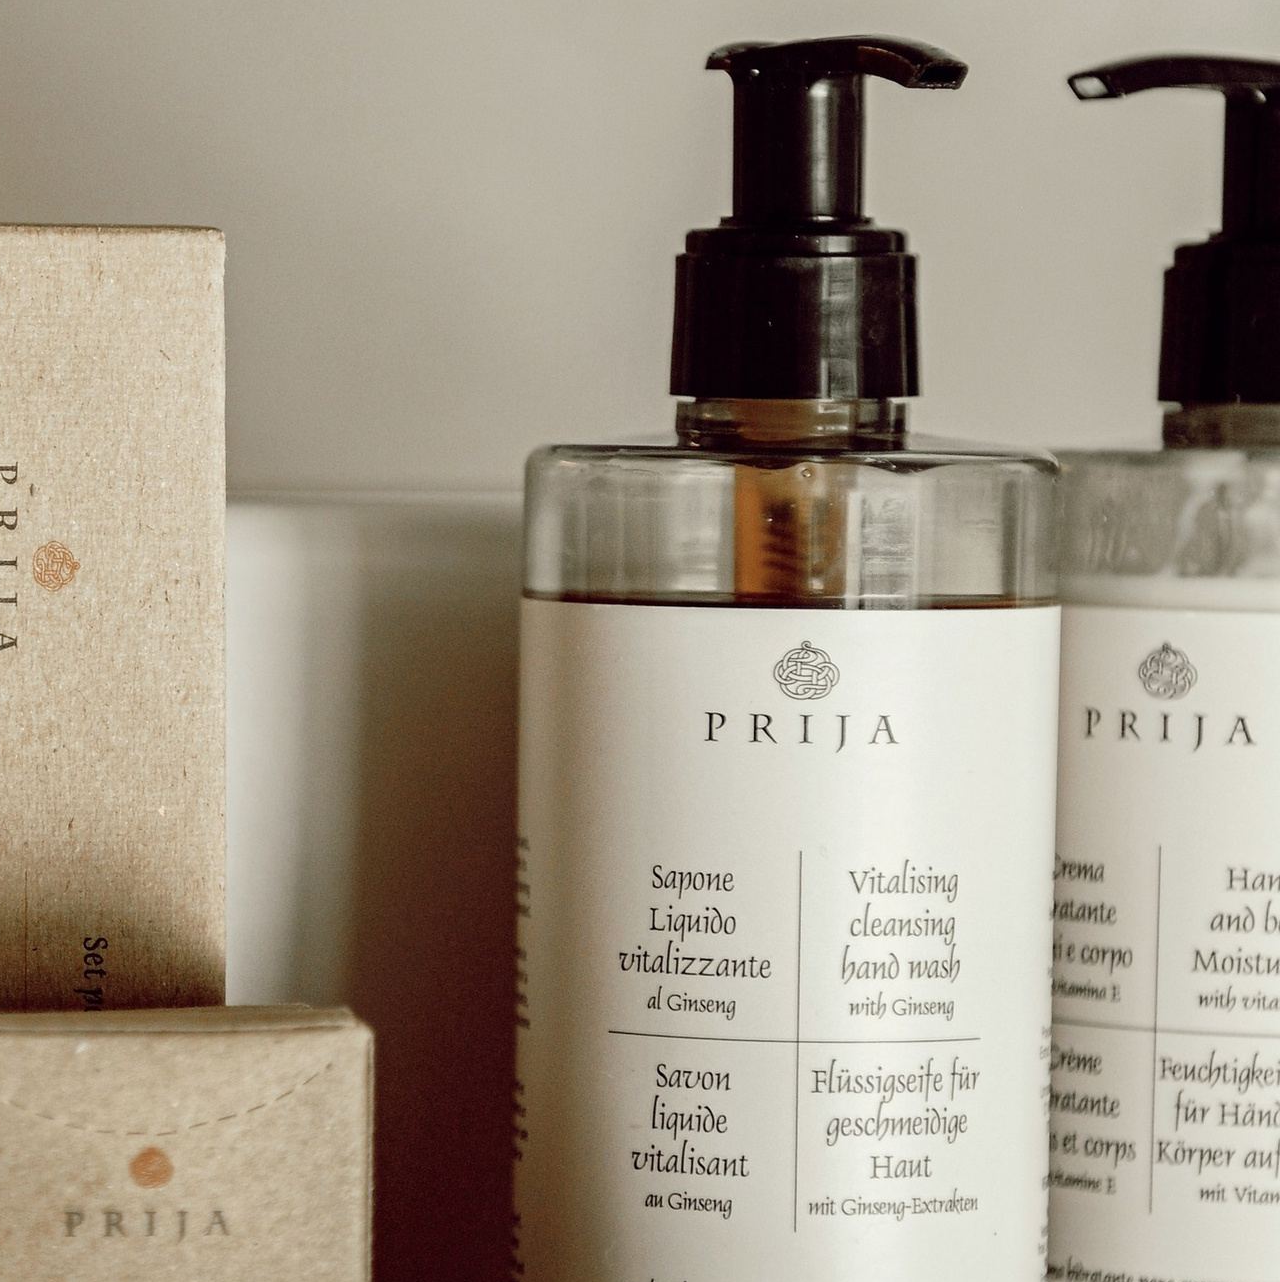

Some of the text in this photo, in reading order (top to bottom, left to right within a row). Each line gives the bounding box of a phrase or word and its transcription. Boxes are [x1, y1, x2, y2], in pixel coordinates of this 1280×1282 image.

[704, 711, 900, 753] PRIJA
[1083, 706, 1258, 753] PRIJA
[651, 864, 735, 900] Sapone
[848, 858, 959, 904] Vitalising
[649, 904, 737, 943] Liquido
[849, 901, 956, 946] cleansing
[1052, 898, 1118, 926] ratante
[1209, 905, 1256, 933] and
[82, 936, 109, 980] Set
[619, 939, 772, 979] vitalizzante
[841, 943, 961, 985] hand wash
[1066, 942, 1076, 963] e
[1080, 943, 1134, 976] corpo
[646, 985, 737, 1021] al Ginseng
[848, 990, 955, 1022] with Ginseng
[1197, 985, 1237, 1013] with
[655, 1063, 732, 1091] Savon
[810, 1056, 980, 1104] Flüssigseife für
[651, 1095, 729, 1141] liquide
[826, 1100, 968, 1147] geschmeidige
[1174, 1089, 1211, 1132] für
[631, 1139, 750, 1178] vitalisant
[869, 1155, 933, 1180] Haut
[1063, 1129, 1078, 1156] et
[1084, 1136, 1137, 1169] corps
[1156, 1139, 1236, 1175] Körper
[645, 1191, 733, 1220] au Ginseng
[808, 1187, 979, 1221] mit Ginseng-Extrakten
[1199, 1184, 1227, 1203] mit
[63, 1209, 231, 1244] PRIJA
